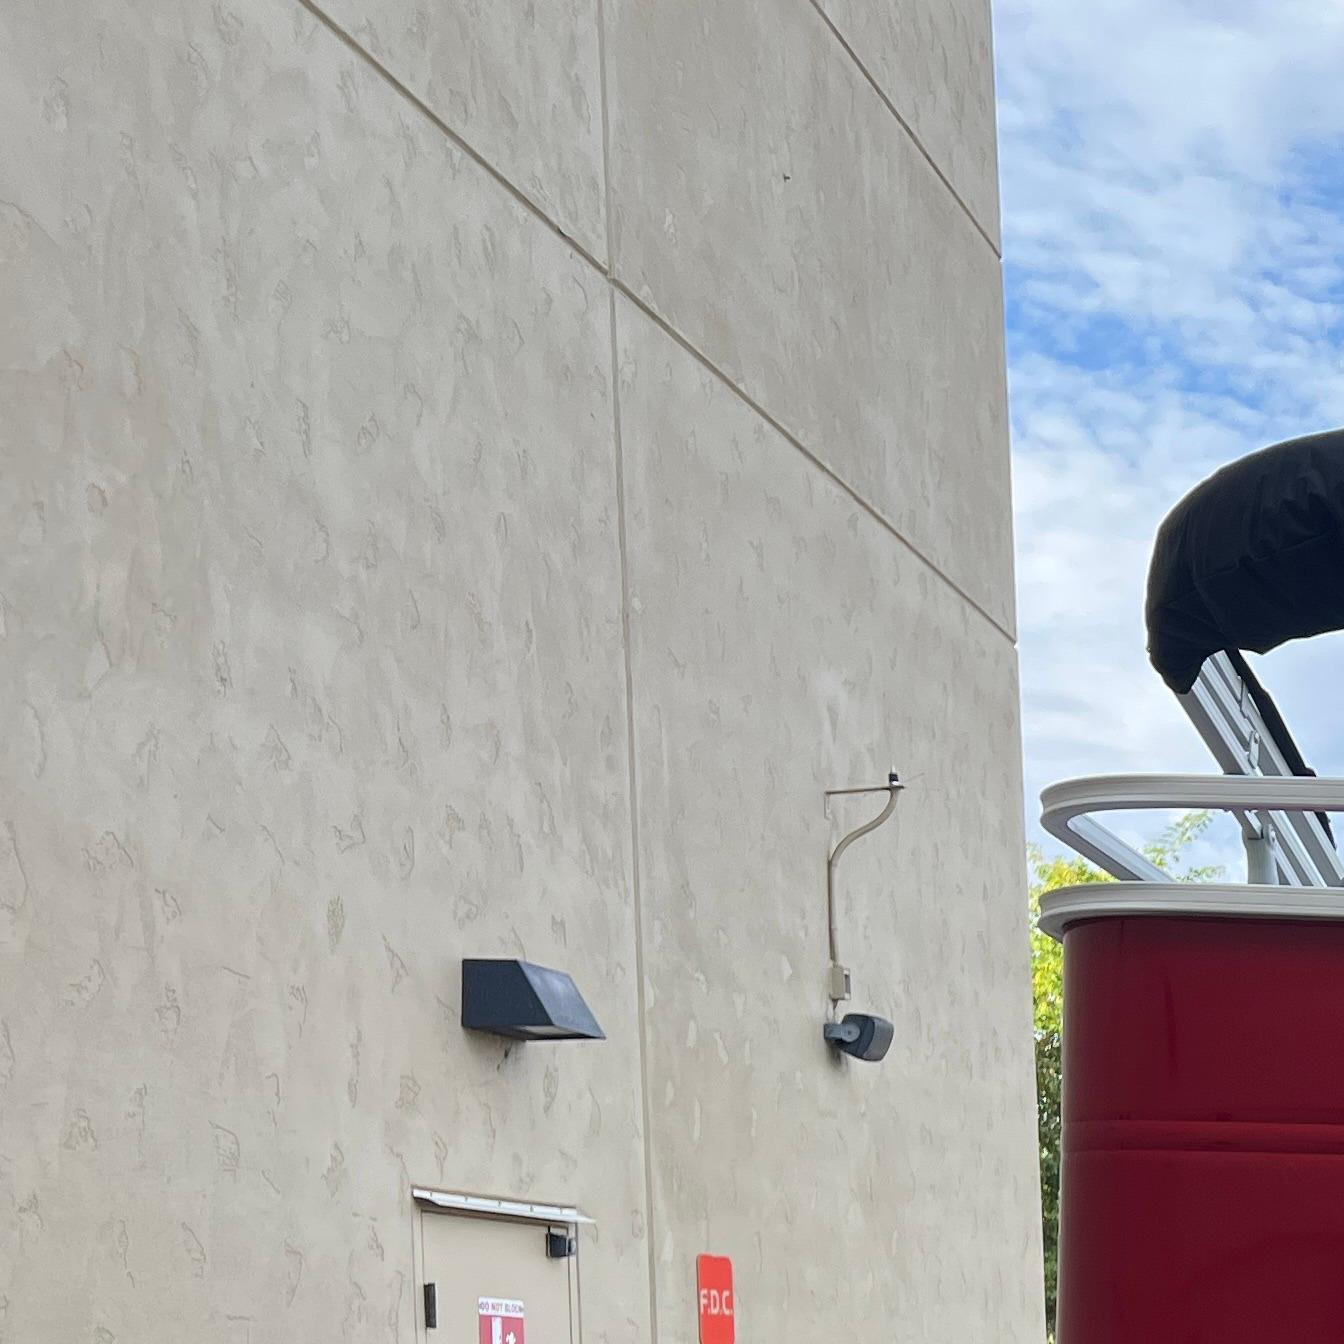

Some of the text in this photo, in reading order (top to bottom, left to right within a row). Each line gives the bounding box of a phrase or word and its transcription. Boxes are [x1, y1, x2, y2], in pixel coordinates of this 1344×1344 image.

[480, 1302, 523, 1313] DO NOT BLOCK
[700, 1289, 734, 1315] F.D.C.
